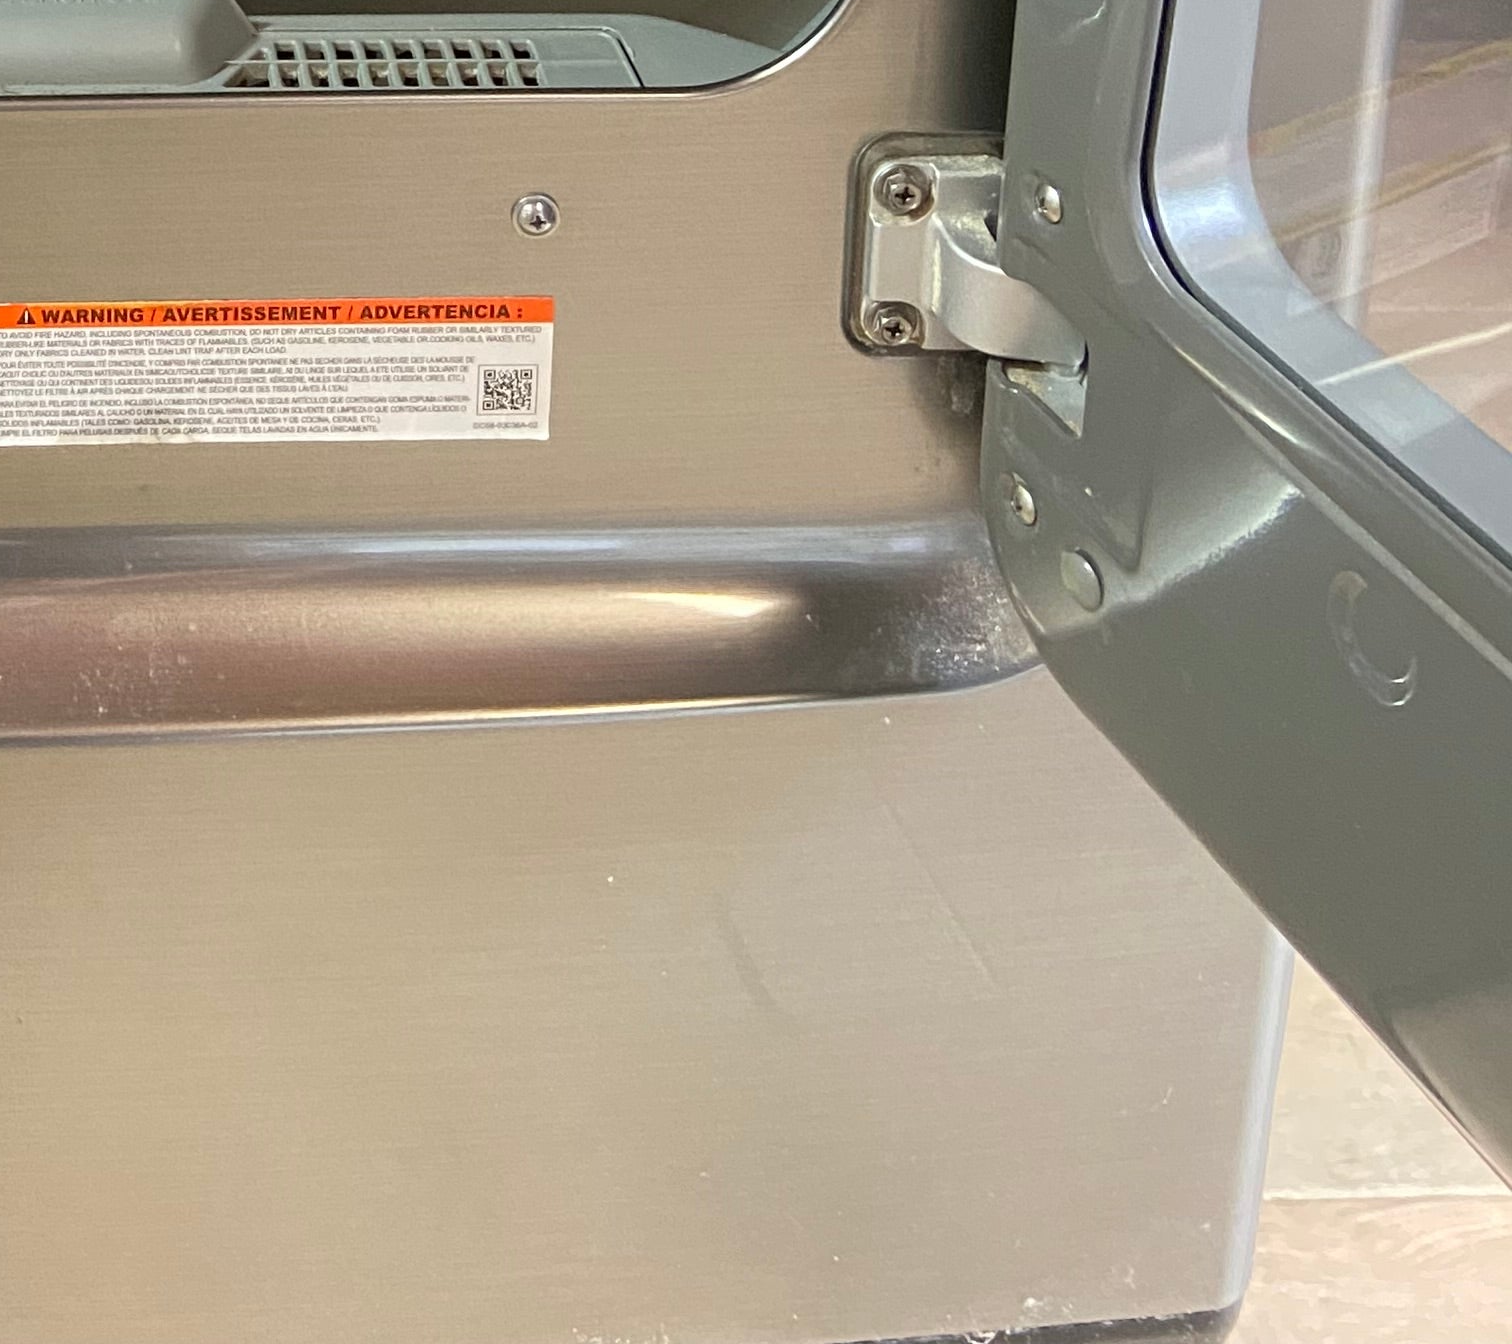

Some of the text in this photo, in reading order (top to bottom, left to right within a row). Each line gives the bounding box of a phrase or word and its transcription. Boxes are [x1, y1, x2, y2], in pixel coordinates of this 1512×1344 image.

[41, 308, 144, 325] WARNING
[162, 306, 342, 323] AVERTISSEMENT
[360, 304, 511, 320] ADVERTENCIA
